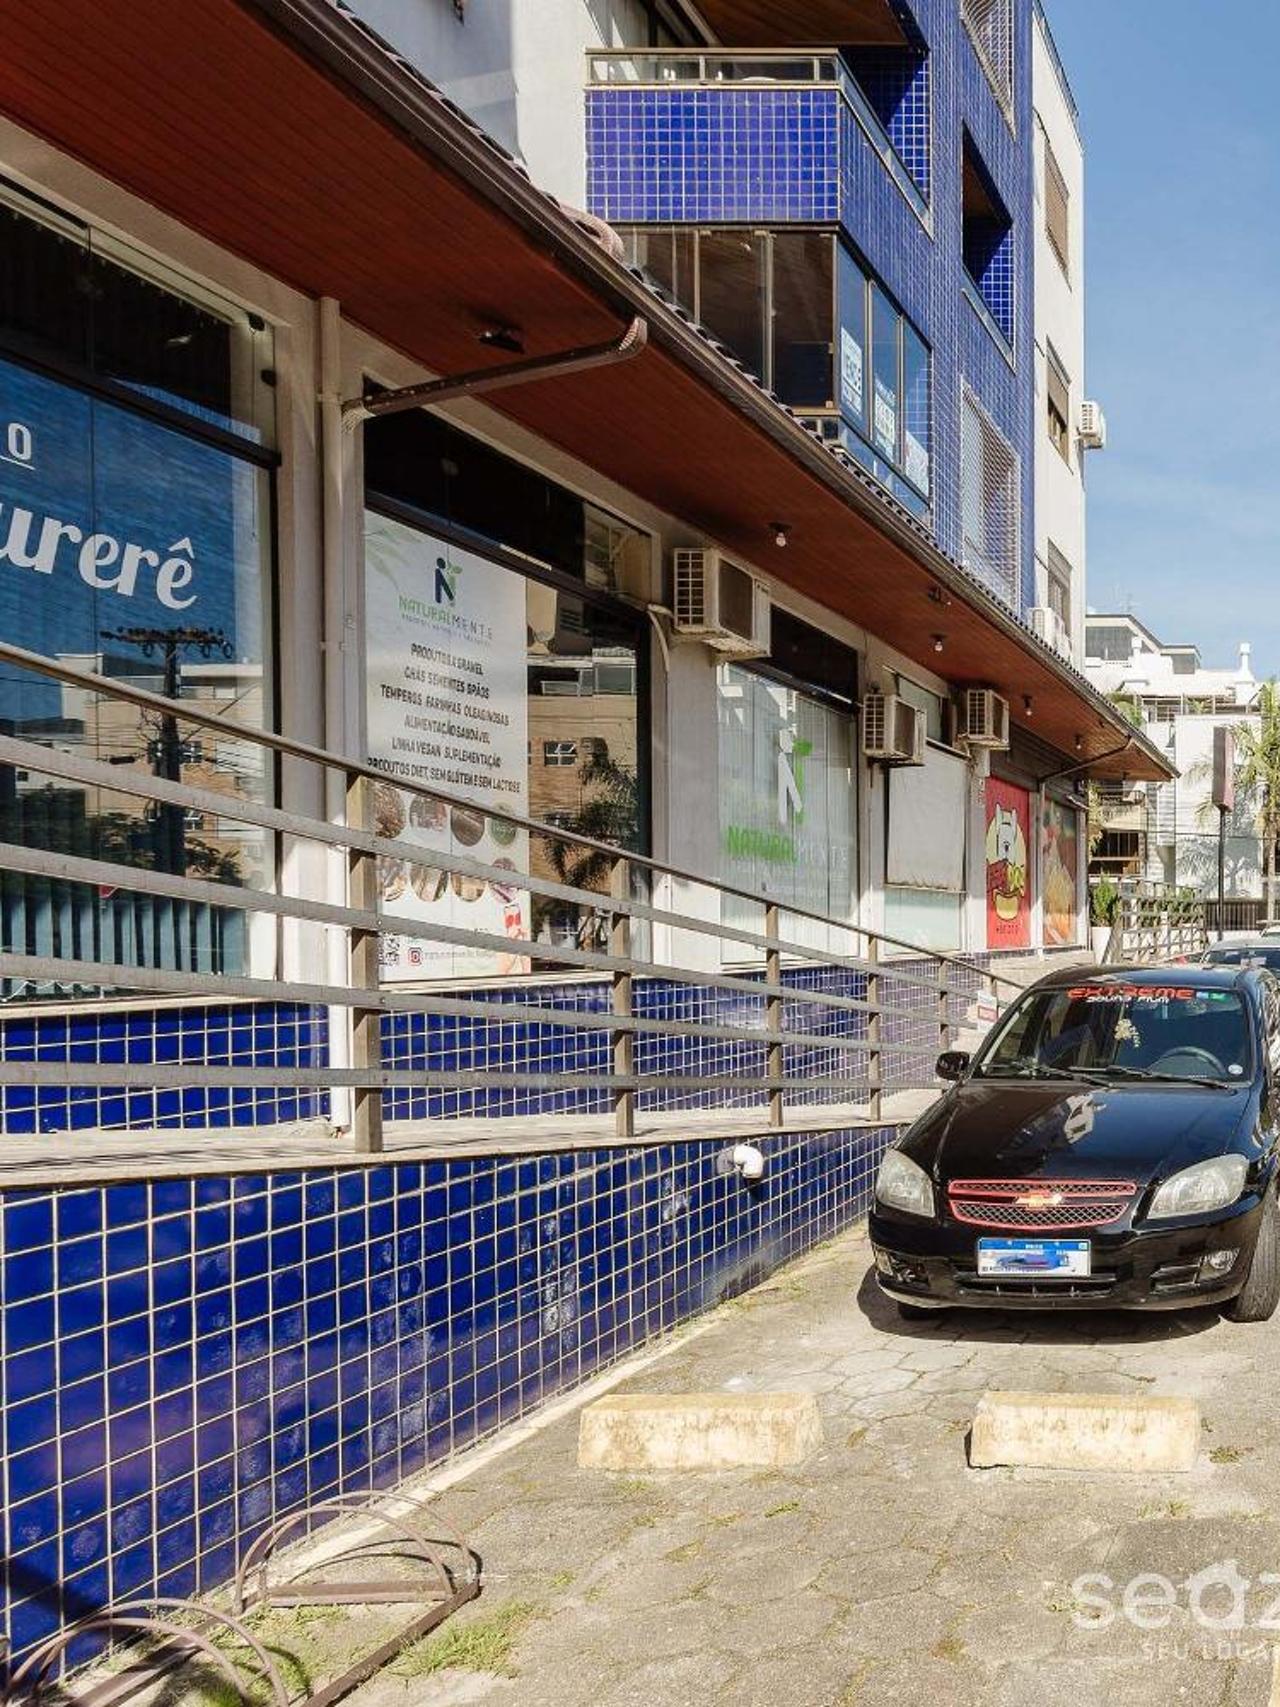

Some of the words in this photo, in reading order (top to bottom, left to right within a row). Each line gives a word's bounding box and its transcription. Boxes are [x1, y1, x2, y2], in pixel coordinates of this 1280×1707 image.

[399, 596, 492, 639] NATURALMENTE
[411, 642, 451, 665] PRODUTOS
[457, 657, 484, 676] GRANEL
[428, 672, 465, 693] SEMENTES
[380, 684, 422, 705] TEMPEROS
[426, 695, 461, 714] FARINHAS
[464, 705, 510, 726] OLEAGINOSAS
[404, 714, 456, 738] ALIMENTAÇÃO
[391, 737, 415, 752] LINHA
[415, 740, 441, 758] VEGAN
[444, 746, 501, 769] SUPLEMENTAÇÃO
[367, 757, 410, 776] PRODUTOS
[430, 767, 446, 781] SEM
[478, 774, 492, 789] SEM
[493, 776, 521, 793] LACTOSE
[1067, 985, 1195, 1000] EXTREME
